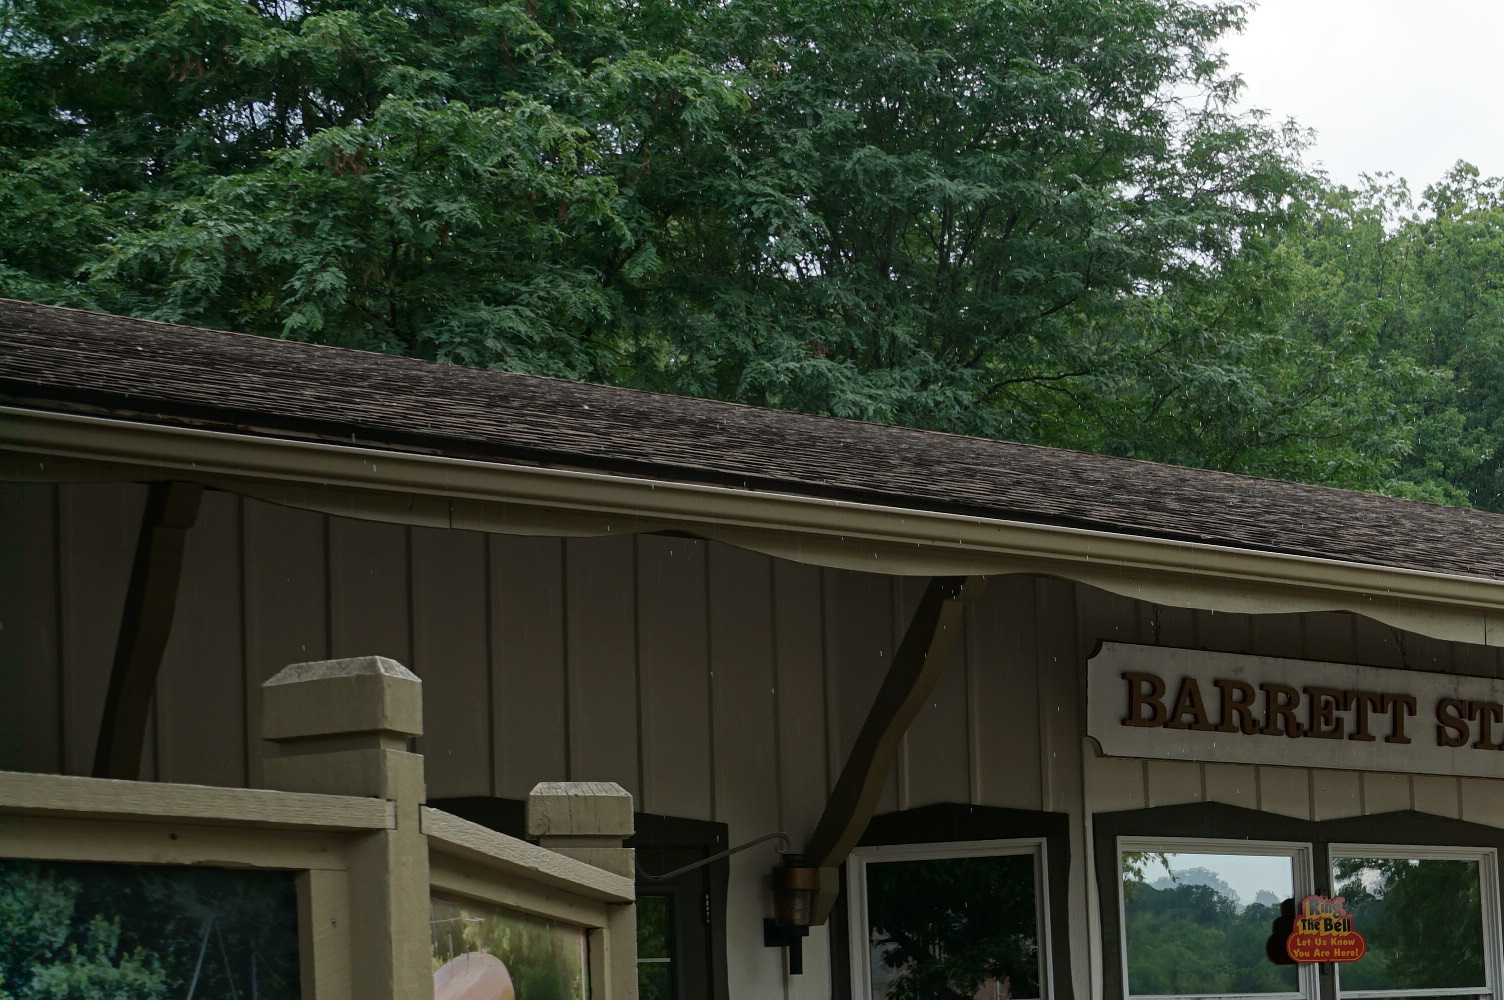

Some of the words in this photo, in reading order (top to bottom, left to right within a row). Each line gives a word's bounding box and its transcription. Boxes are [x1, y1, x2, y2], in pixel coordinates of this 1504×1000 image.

[1121, 672, 1417, 744] BARRETT
[1309, 898, 1343, 918] Ring
[1301, 919, 1320, 930] The
[1323, 918, 1351, 932] Bell
[1296, 938, 1312, 946] Let
[1315, 938, 1327, 946] Us
[1331, 938, 1355, 946] Know
[1293, 949, 1310, 957] You
[1313, 949, 1330, 957] Are
[1334, 948, 1359, 957] Here!
